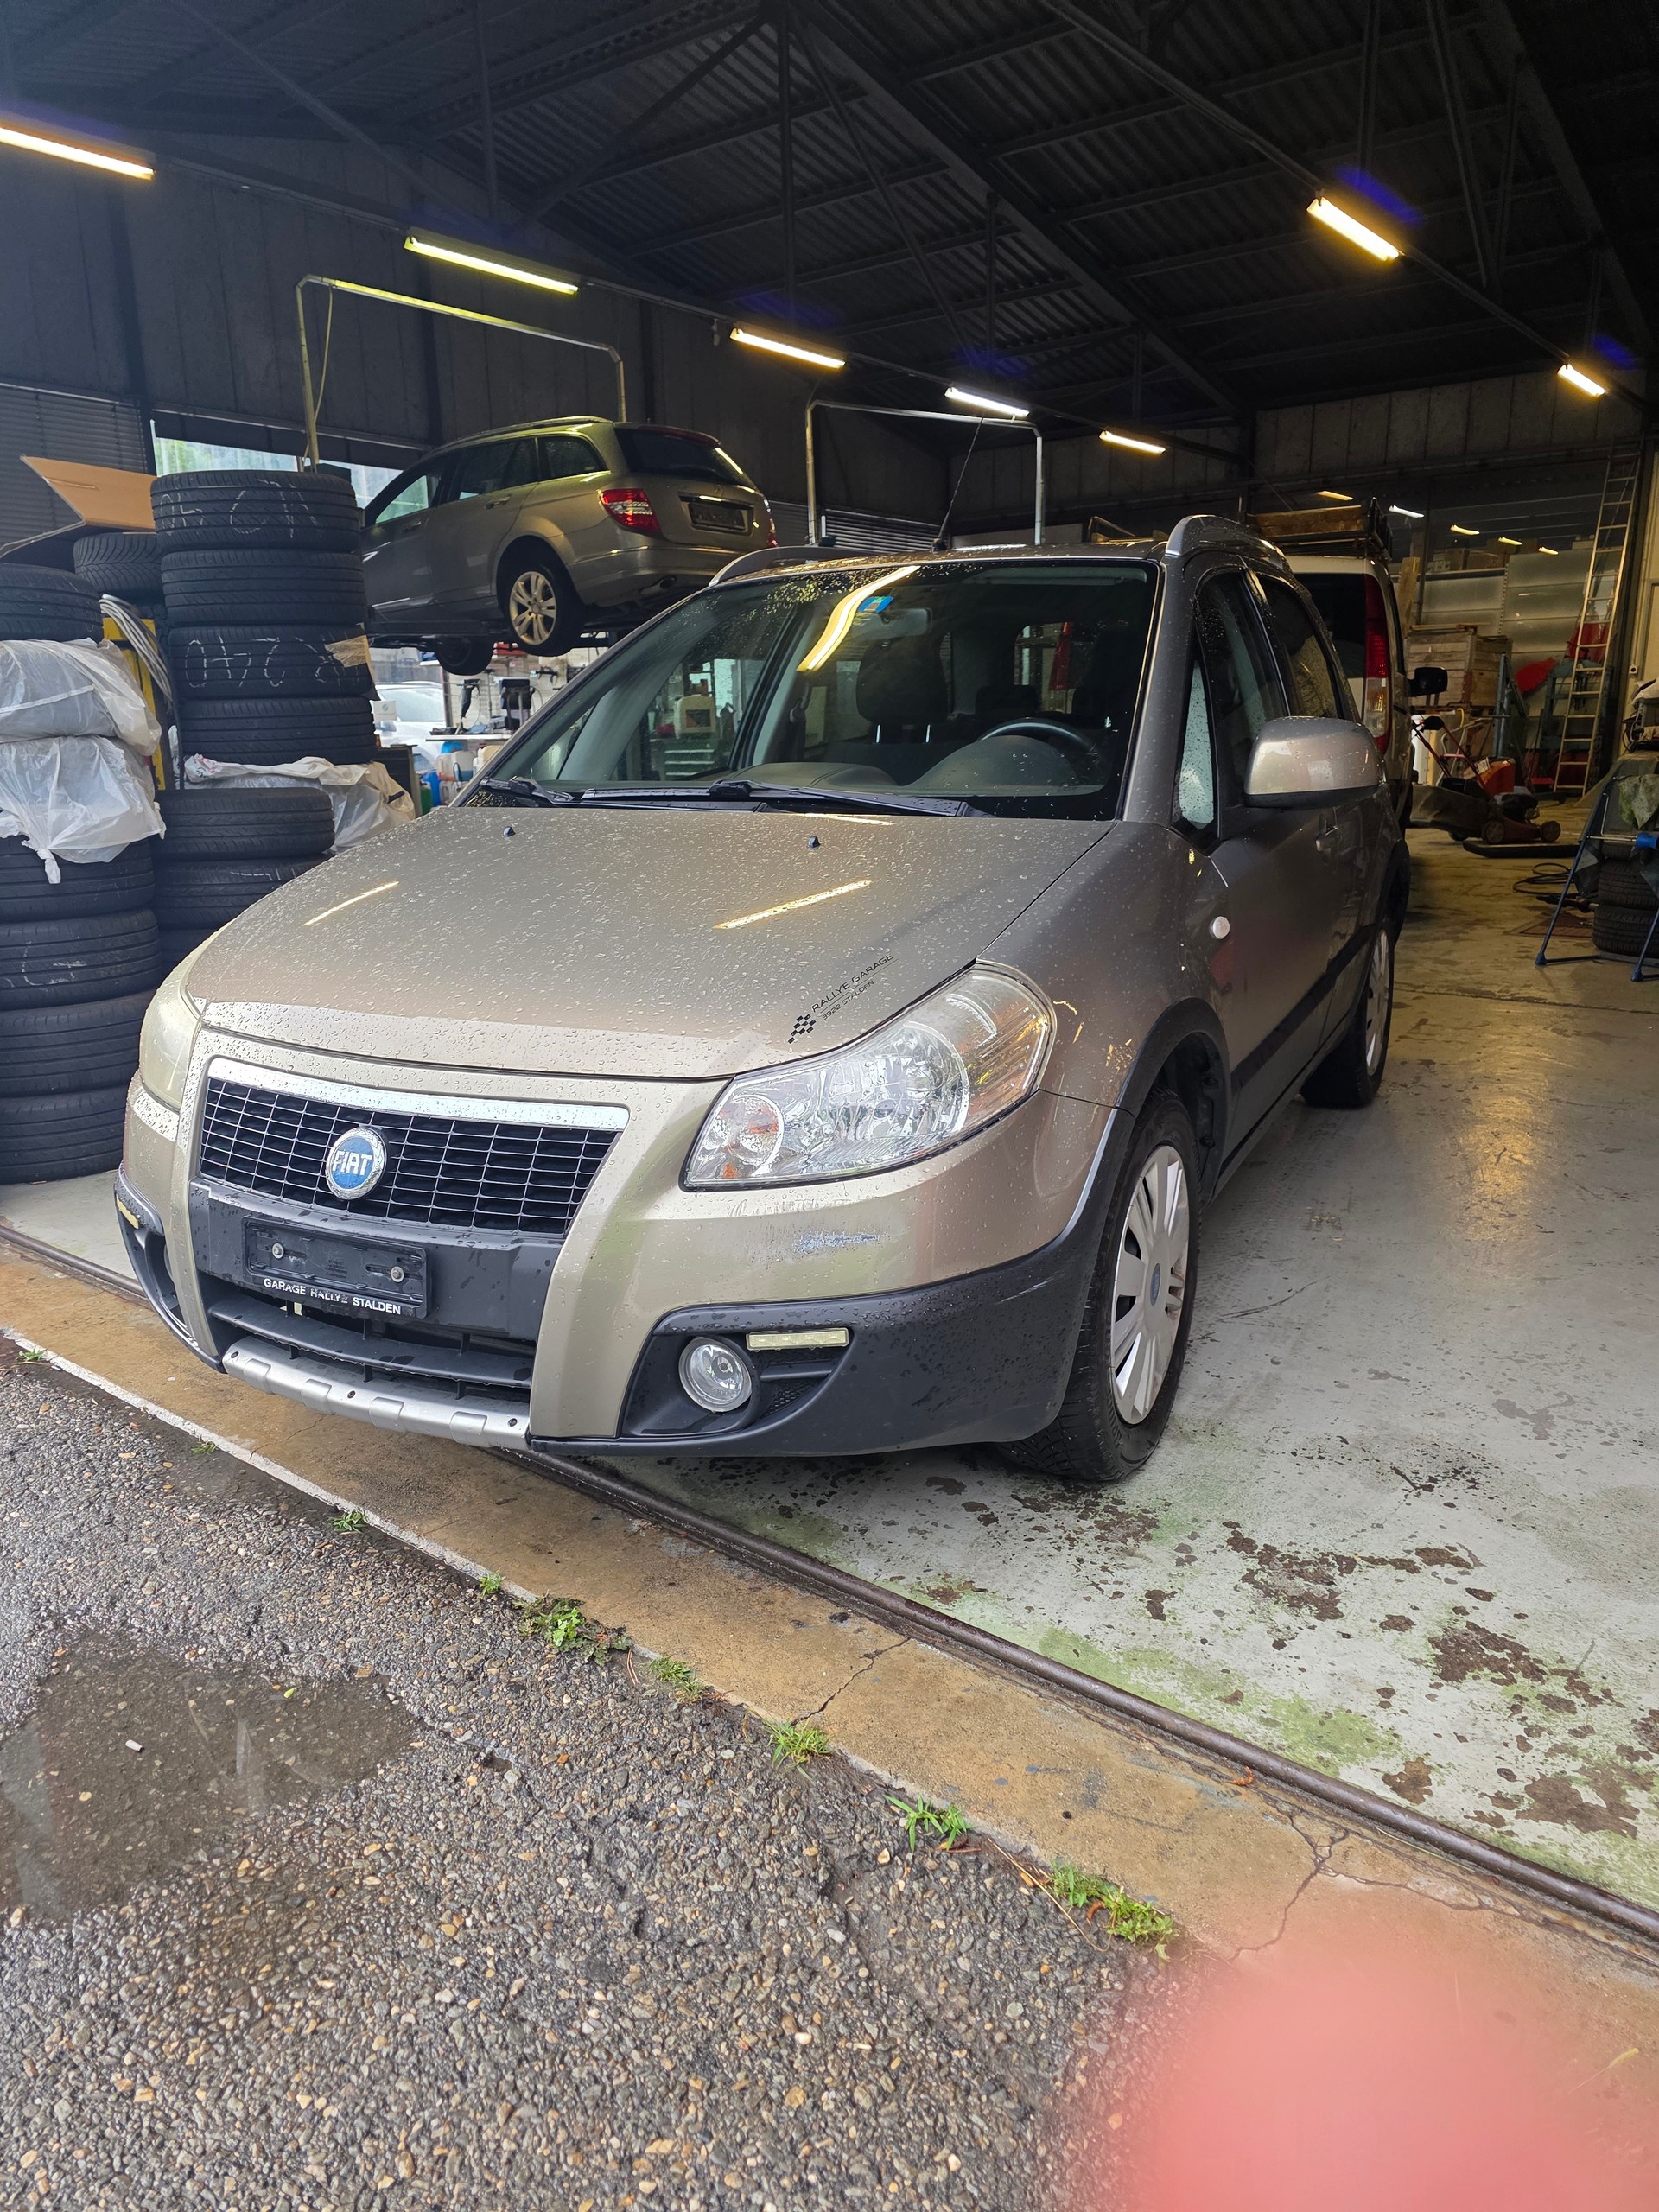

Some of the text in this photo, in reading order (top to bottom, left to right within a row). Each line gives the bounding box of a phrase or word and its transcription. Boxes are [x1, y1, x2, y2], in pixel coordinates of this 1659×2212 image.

[812, 952, 893, 1013] RALLYE GARAGE
[822, 980, 874, 1020] 3922 STALDEN
[332, 1149, 373, 1176] FIAT
[264, 1278, 306, 1295] GARAGE
[353, 1297, 401, 1315] STALDEN
